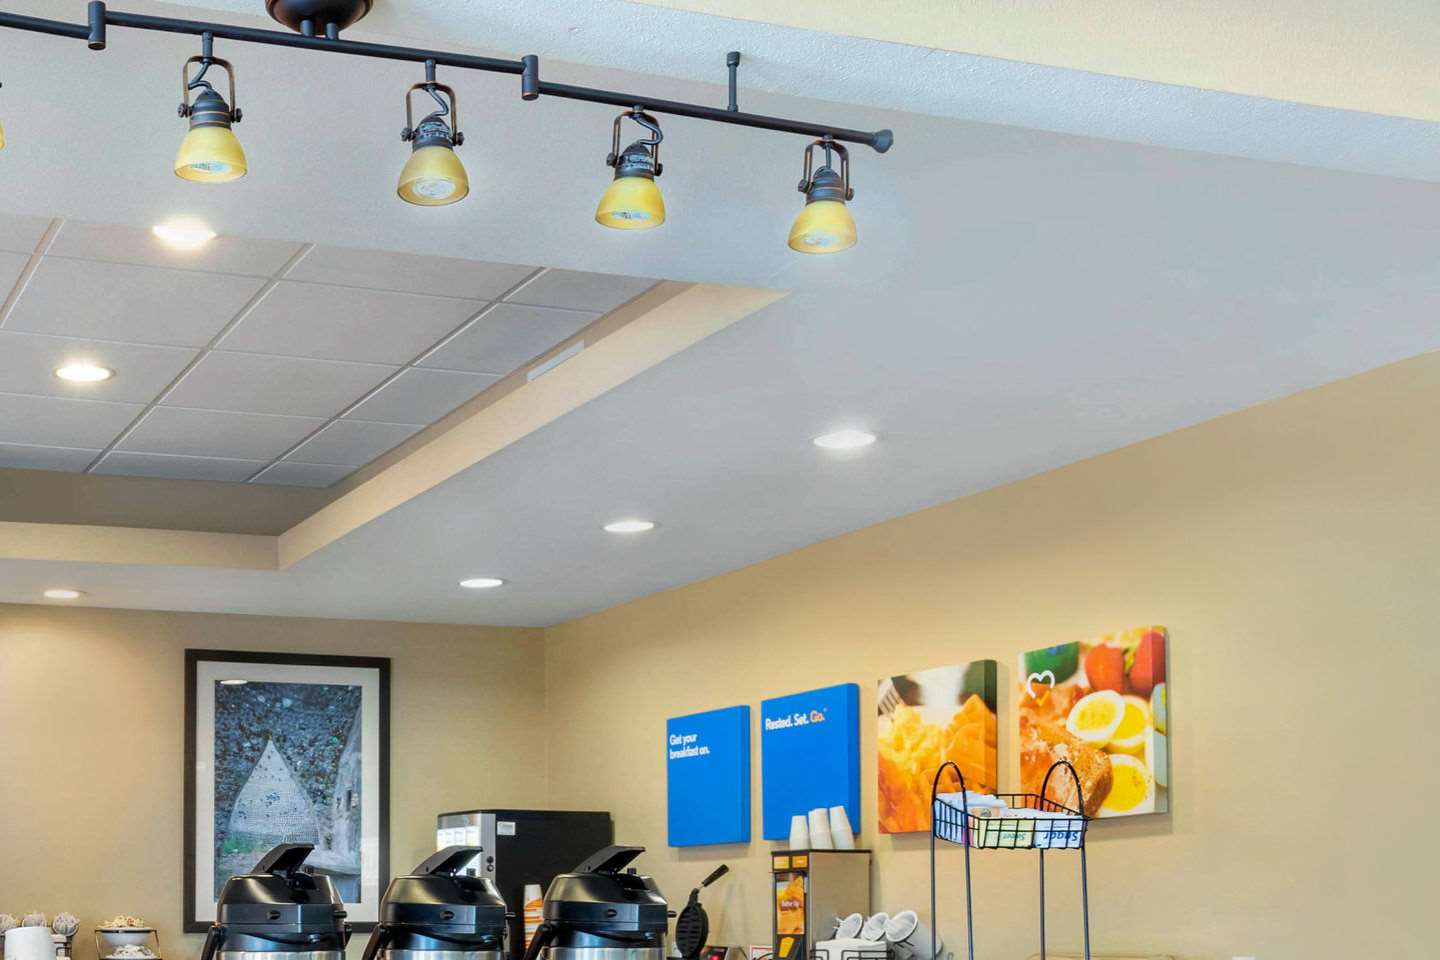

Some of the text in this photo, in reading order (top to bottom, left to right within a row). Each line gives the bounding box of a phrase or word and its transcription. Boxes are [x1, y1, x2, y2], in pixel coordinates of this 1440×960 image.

[765, 714, 793, 730] Rested.
[793, 713, 809, 726] Set.
[669, 734, 698, 747] Get your
[669, 745, 699, 760] breakfast
